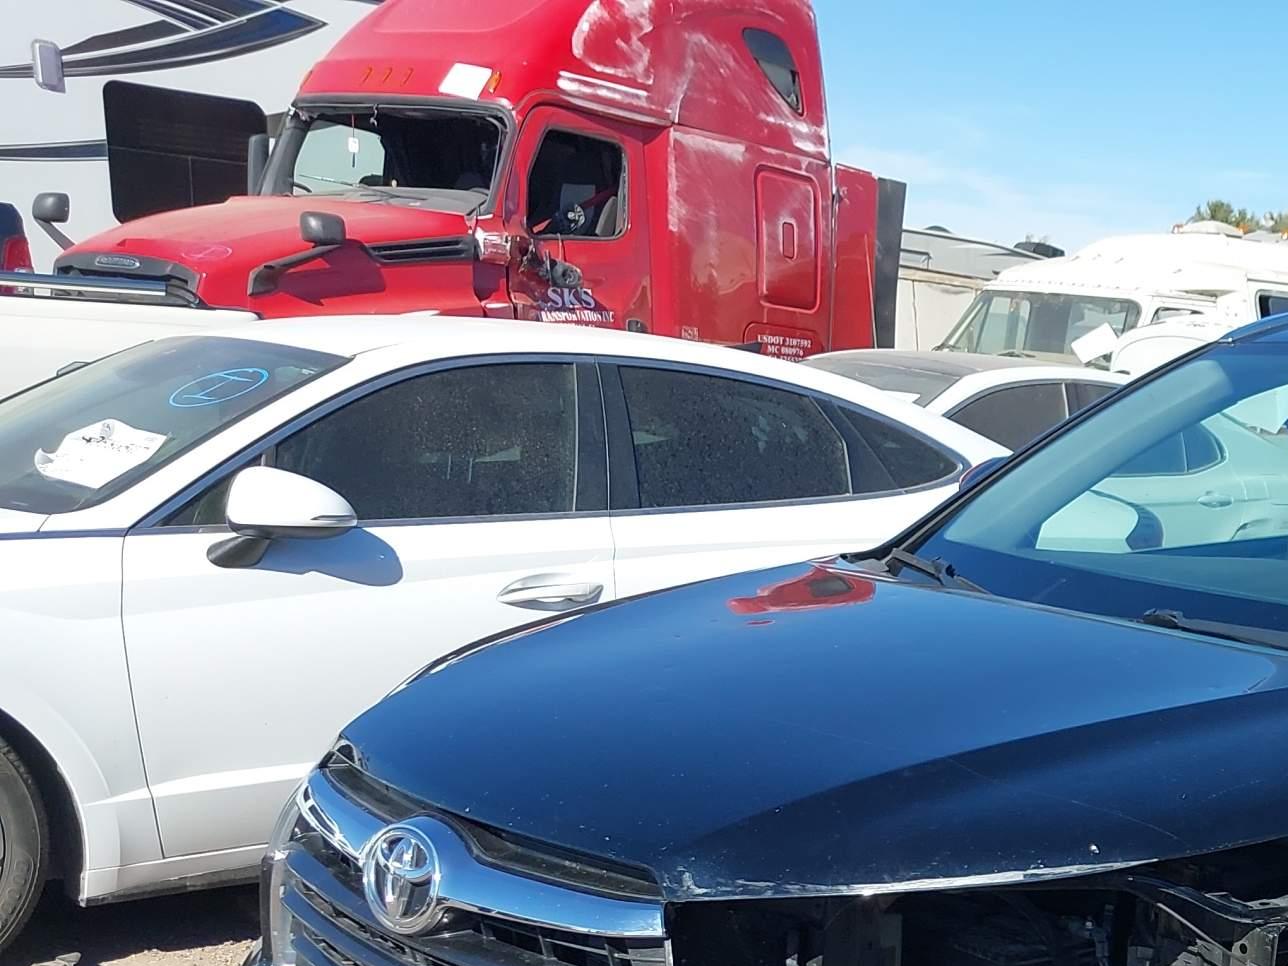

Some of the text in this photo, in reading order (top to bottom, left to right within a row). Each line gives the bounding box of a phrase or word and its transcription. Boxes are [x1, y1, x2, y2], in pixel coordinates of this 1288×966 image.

[548, 287, 595, 308] SKS
[757, 334, 785, 345] USDOT
[767, 345, 780, 353] MC
